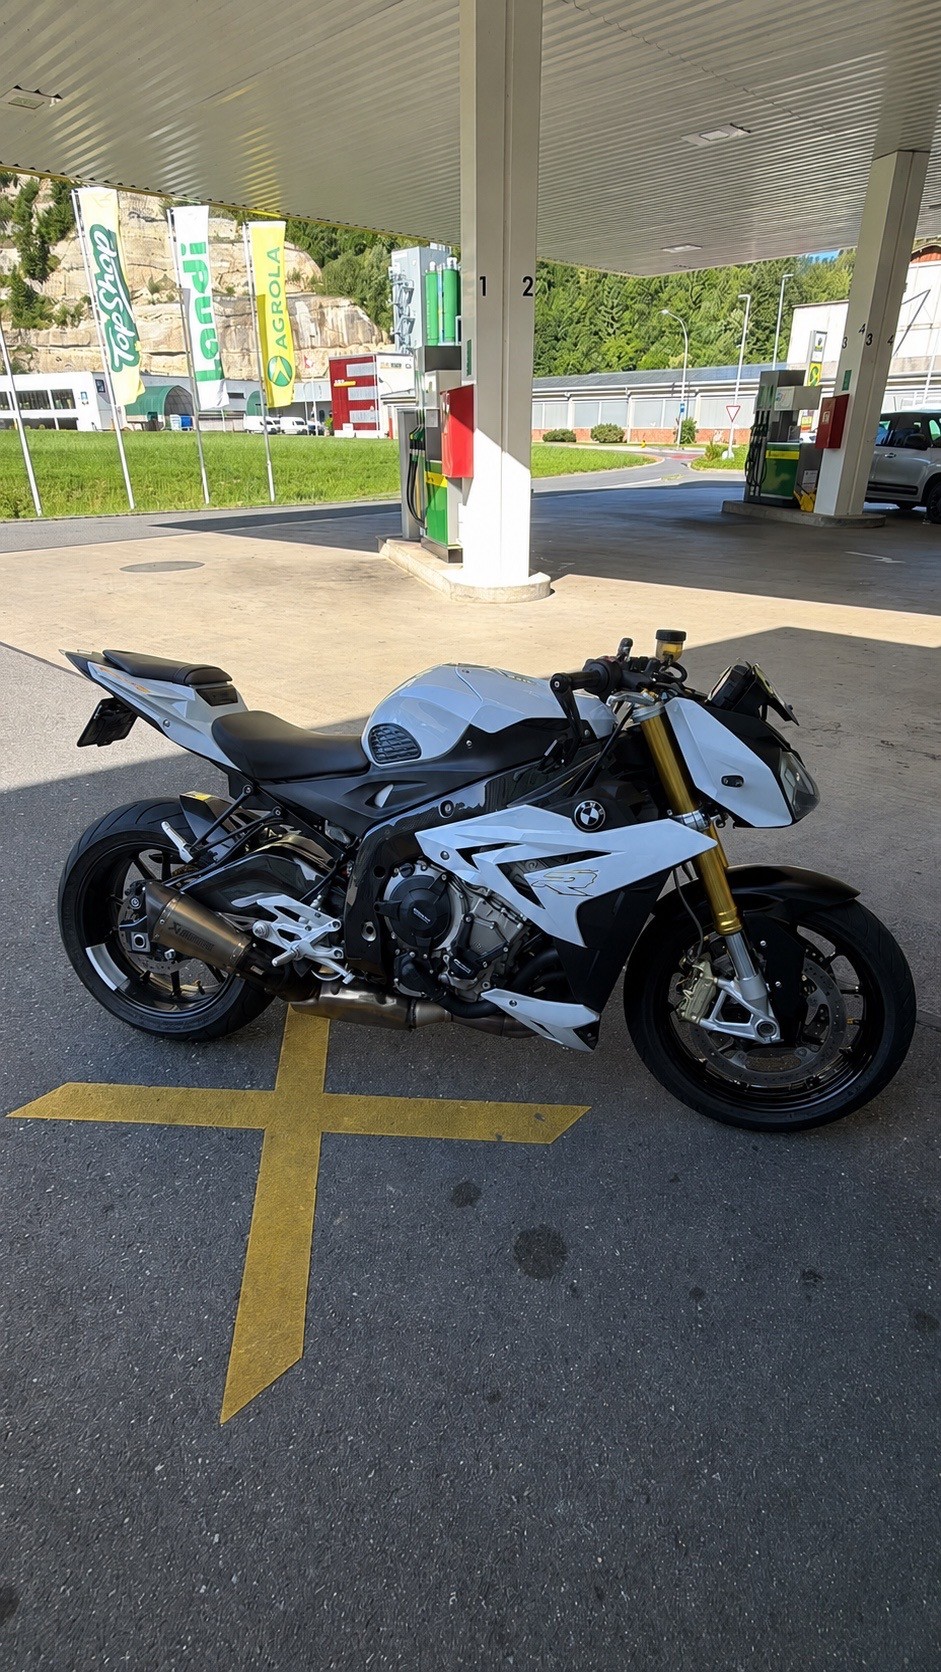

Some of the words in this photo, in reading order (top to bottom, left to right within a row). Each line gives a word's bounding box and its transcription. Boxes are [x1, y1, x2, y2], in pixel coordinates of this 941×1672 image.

[479, 276, 486, 297] 1
[522, 275, 534, 297] 2
[266, 246, 288, 350] AGROLA
[841, 336, 848, 349] 3
[866, 333, 873, 346] 3
